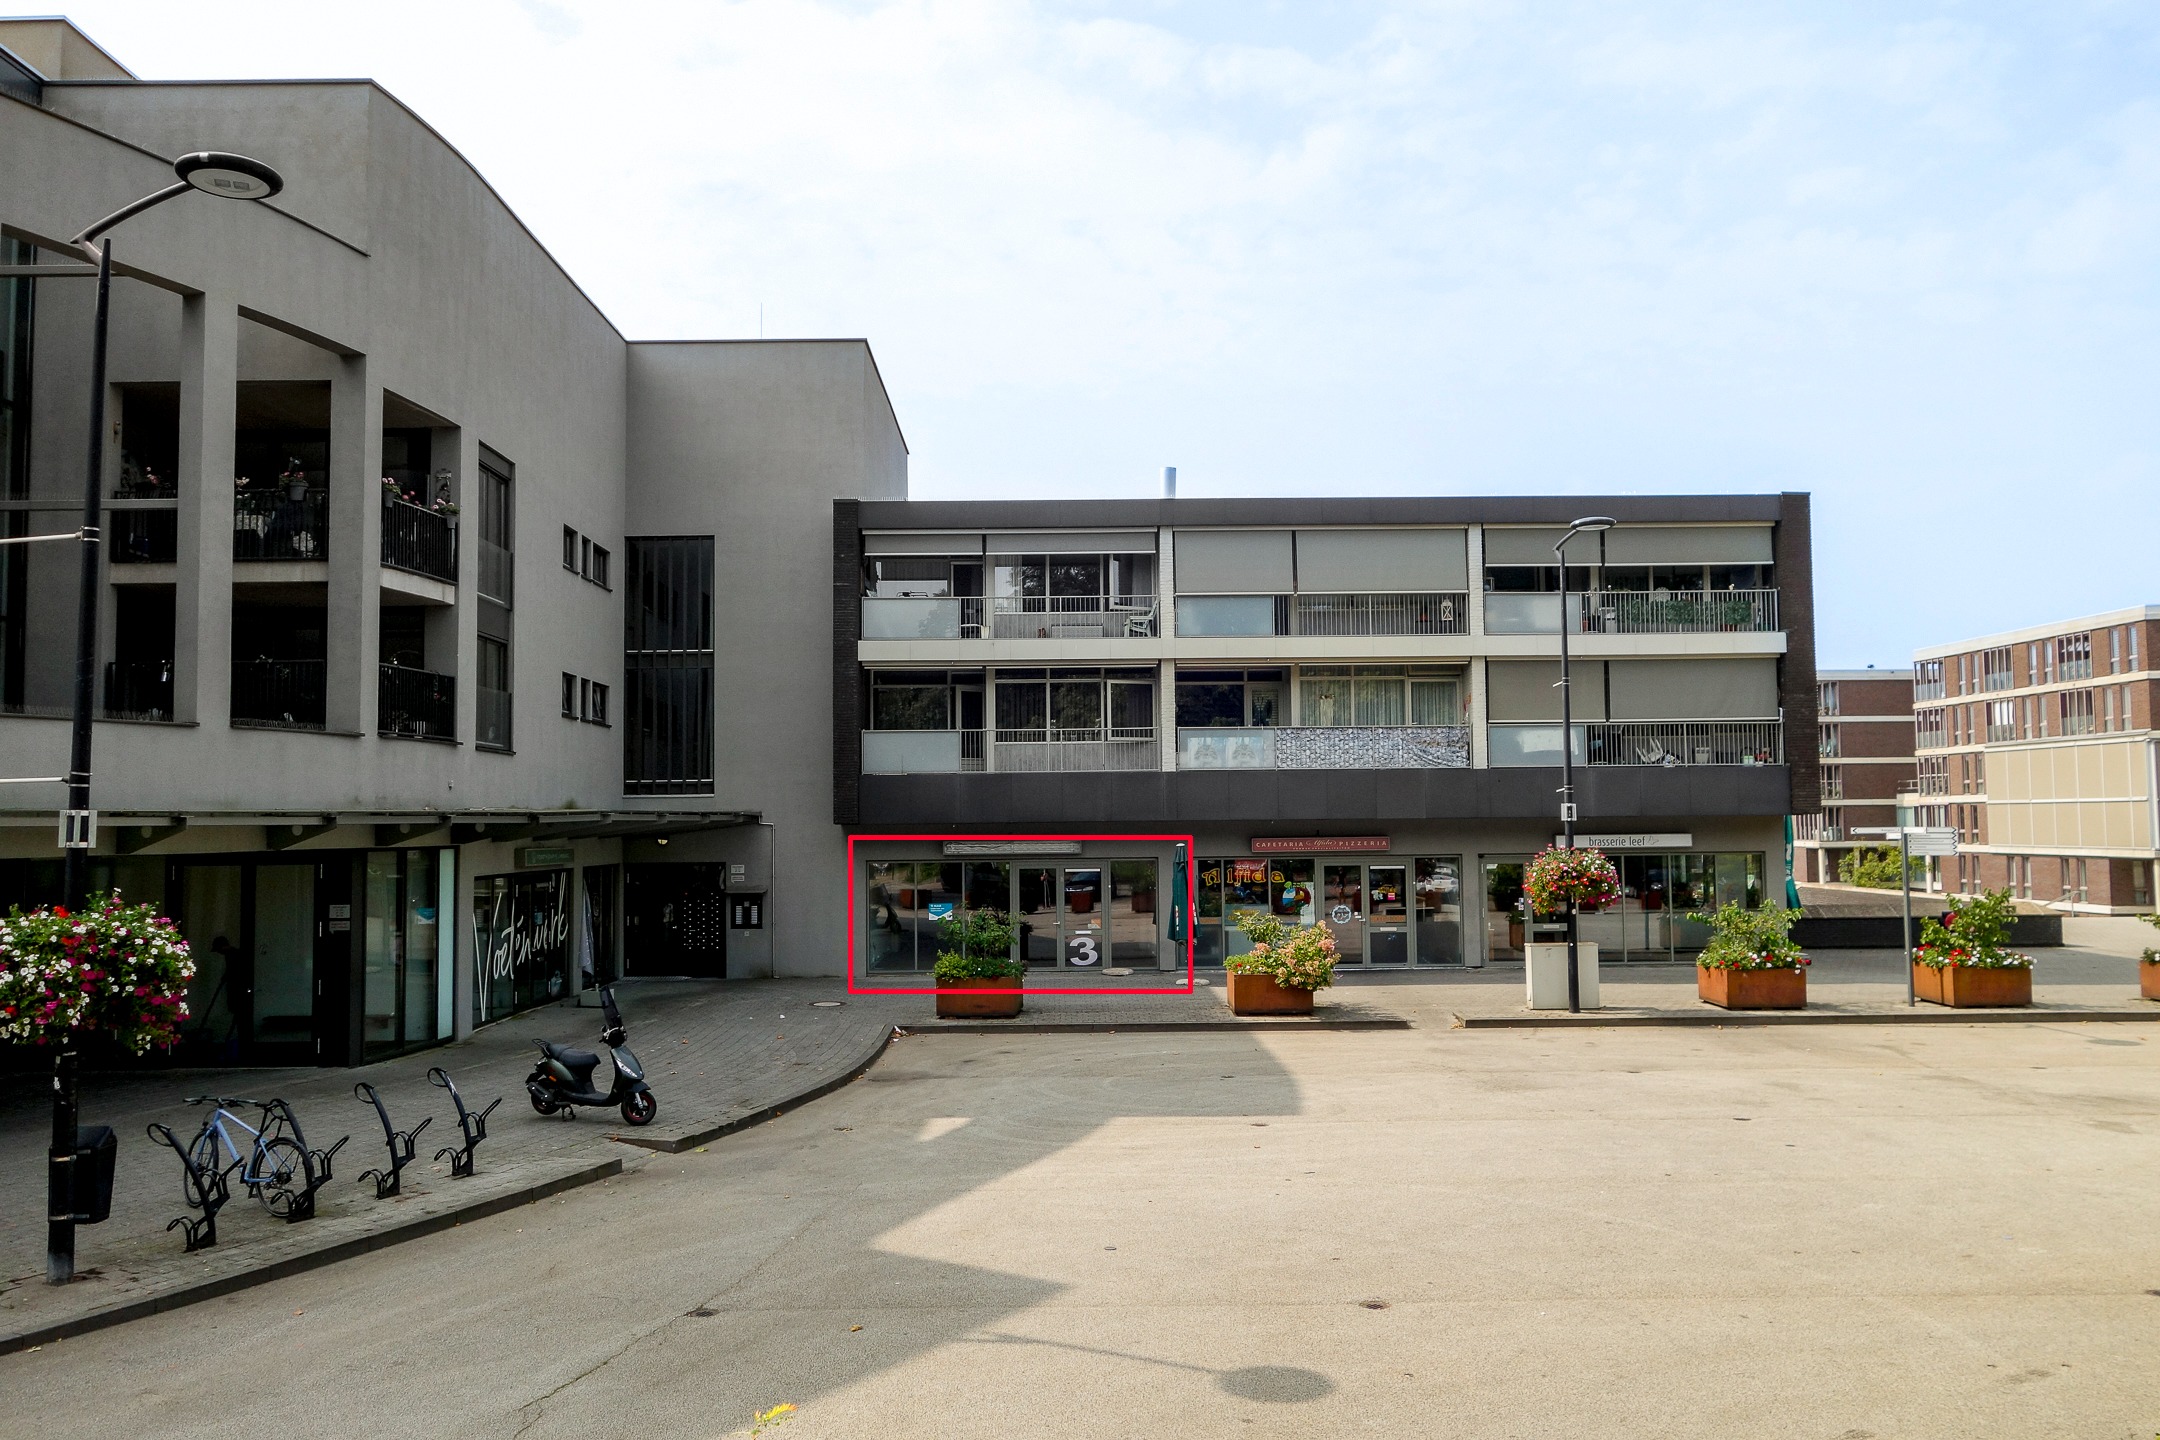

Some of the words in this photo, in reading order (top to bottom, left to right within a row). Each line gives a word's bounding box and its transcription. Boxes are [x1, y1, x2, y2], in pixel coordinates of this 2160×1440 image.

[1588, 836, 1626, 846] brasserie
[1629, 836, 1645, 846] leef
[1202, 867, 1285, 886] Alfida
[1069, 937, 1098, 966] 3
